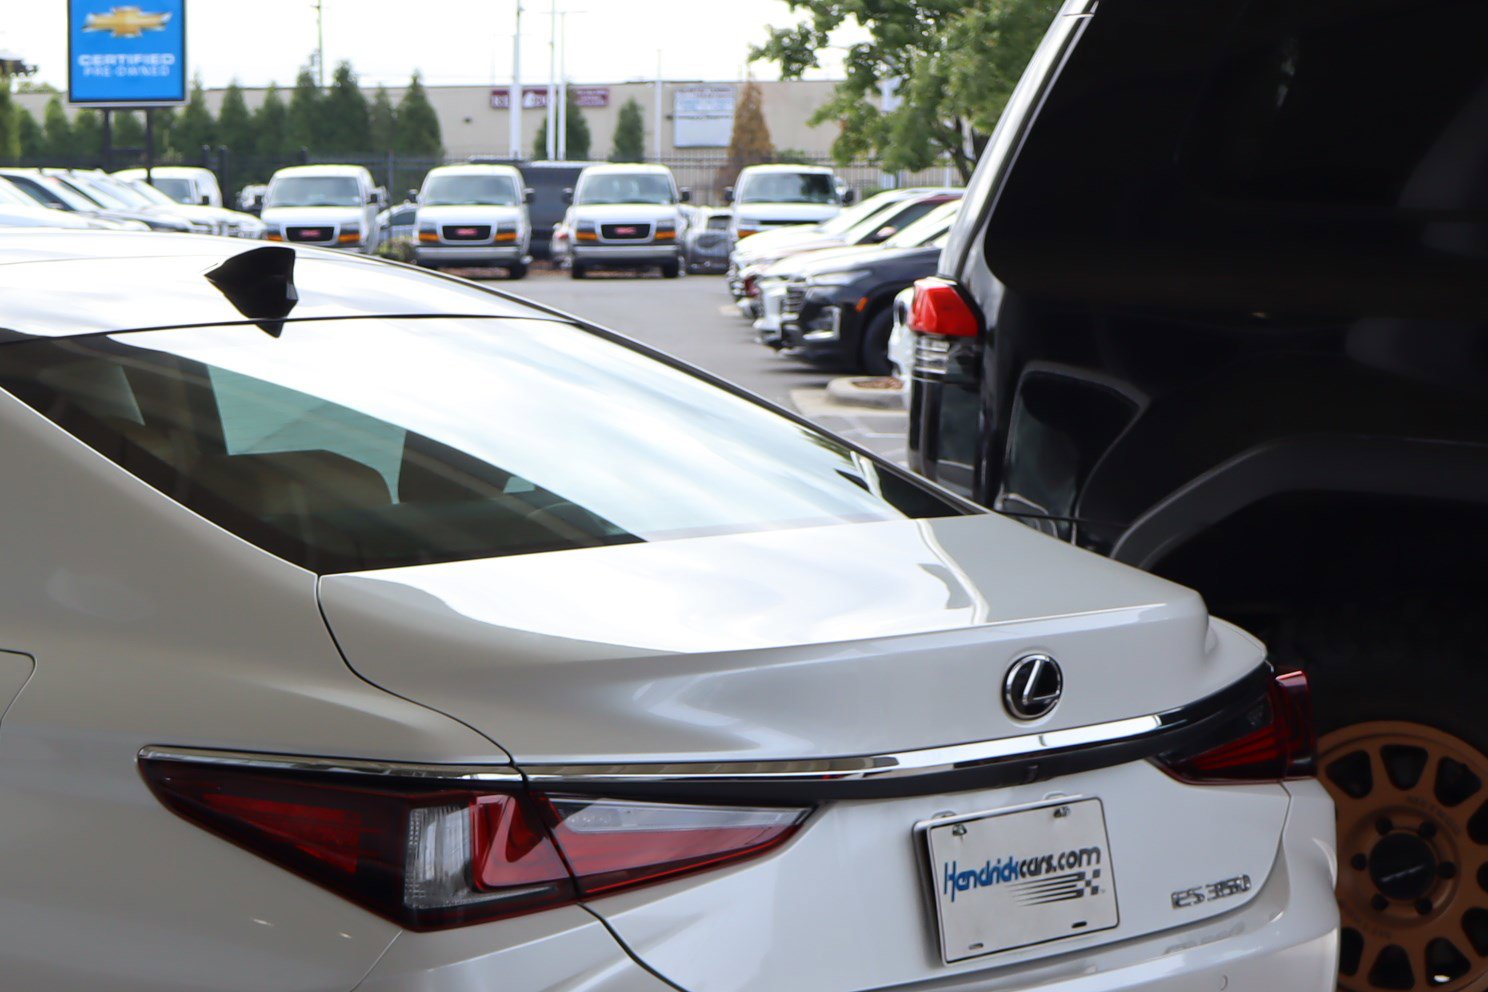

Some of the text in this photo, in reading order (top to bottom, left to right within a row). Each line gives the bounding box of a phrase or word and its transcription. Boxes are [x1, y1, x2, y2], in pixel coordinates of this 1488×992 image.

[78, 54, 175, 66] CERTIFIED
[944, 846, 1101, 902] Hendrickcars.com
[1171, 886, 1205, 909] ES
